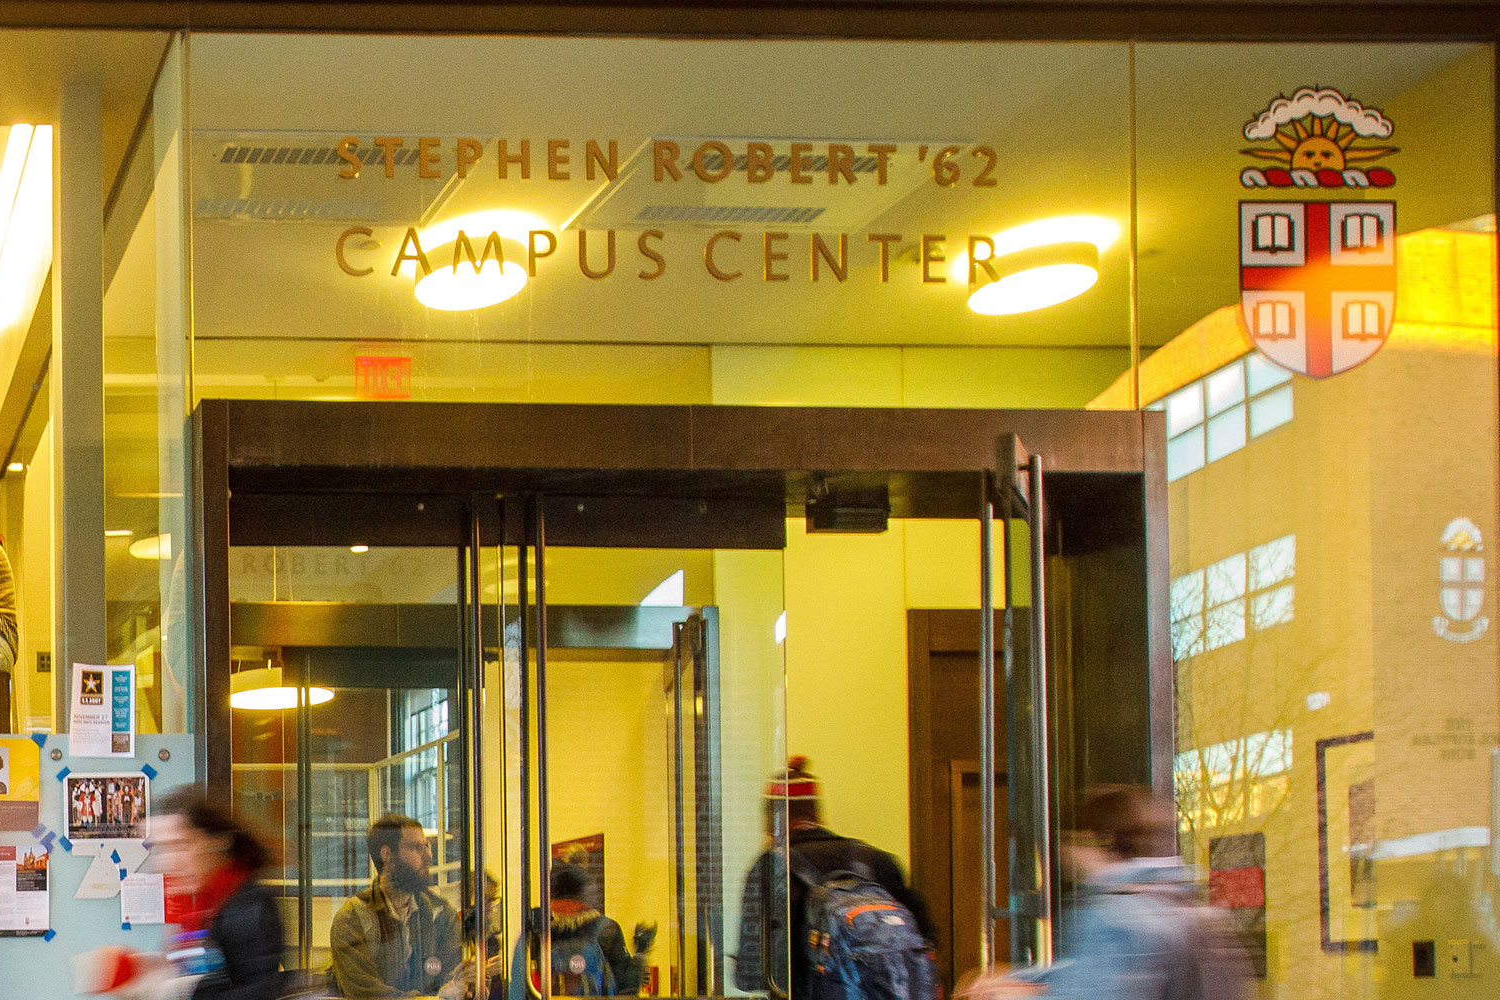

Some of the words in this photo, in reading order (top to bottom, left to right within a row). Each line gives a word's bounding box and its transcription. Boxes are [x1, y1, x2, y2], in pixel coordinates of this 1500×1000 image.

[336, 136, 619, 181] STEPHEN
[653, 141, 896, 186] ROBERT
[918, 146, 998, 188] '62
[335, 226, 666, 280] CAMPUS
[704, 232, 1001, 283] CENTER
